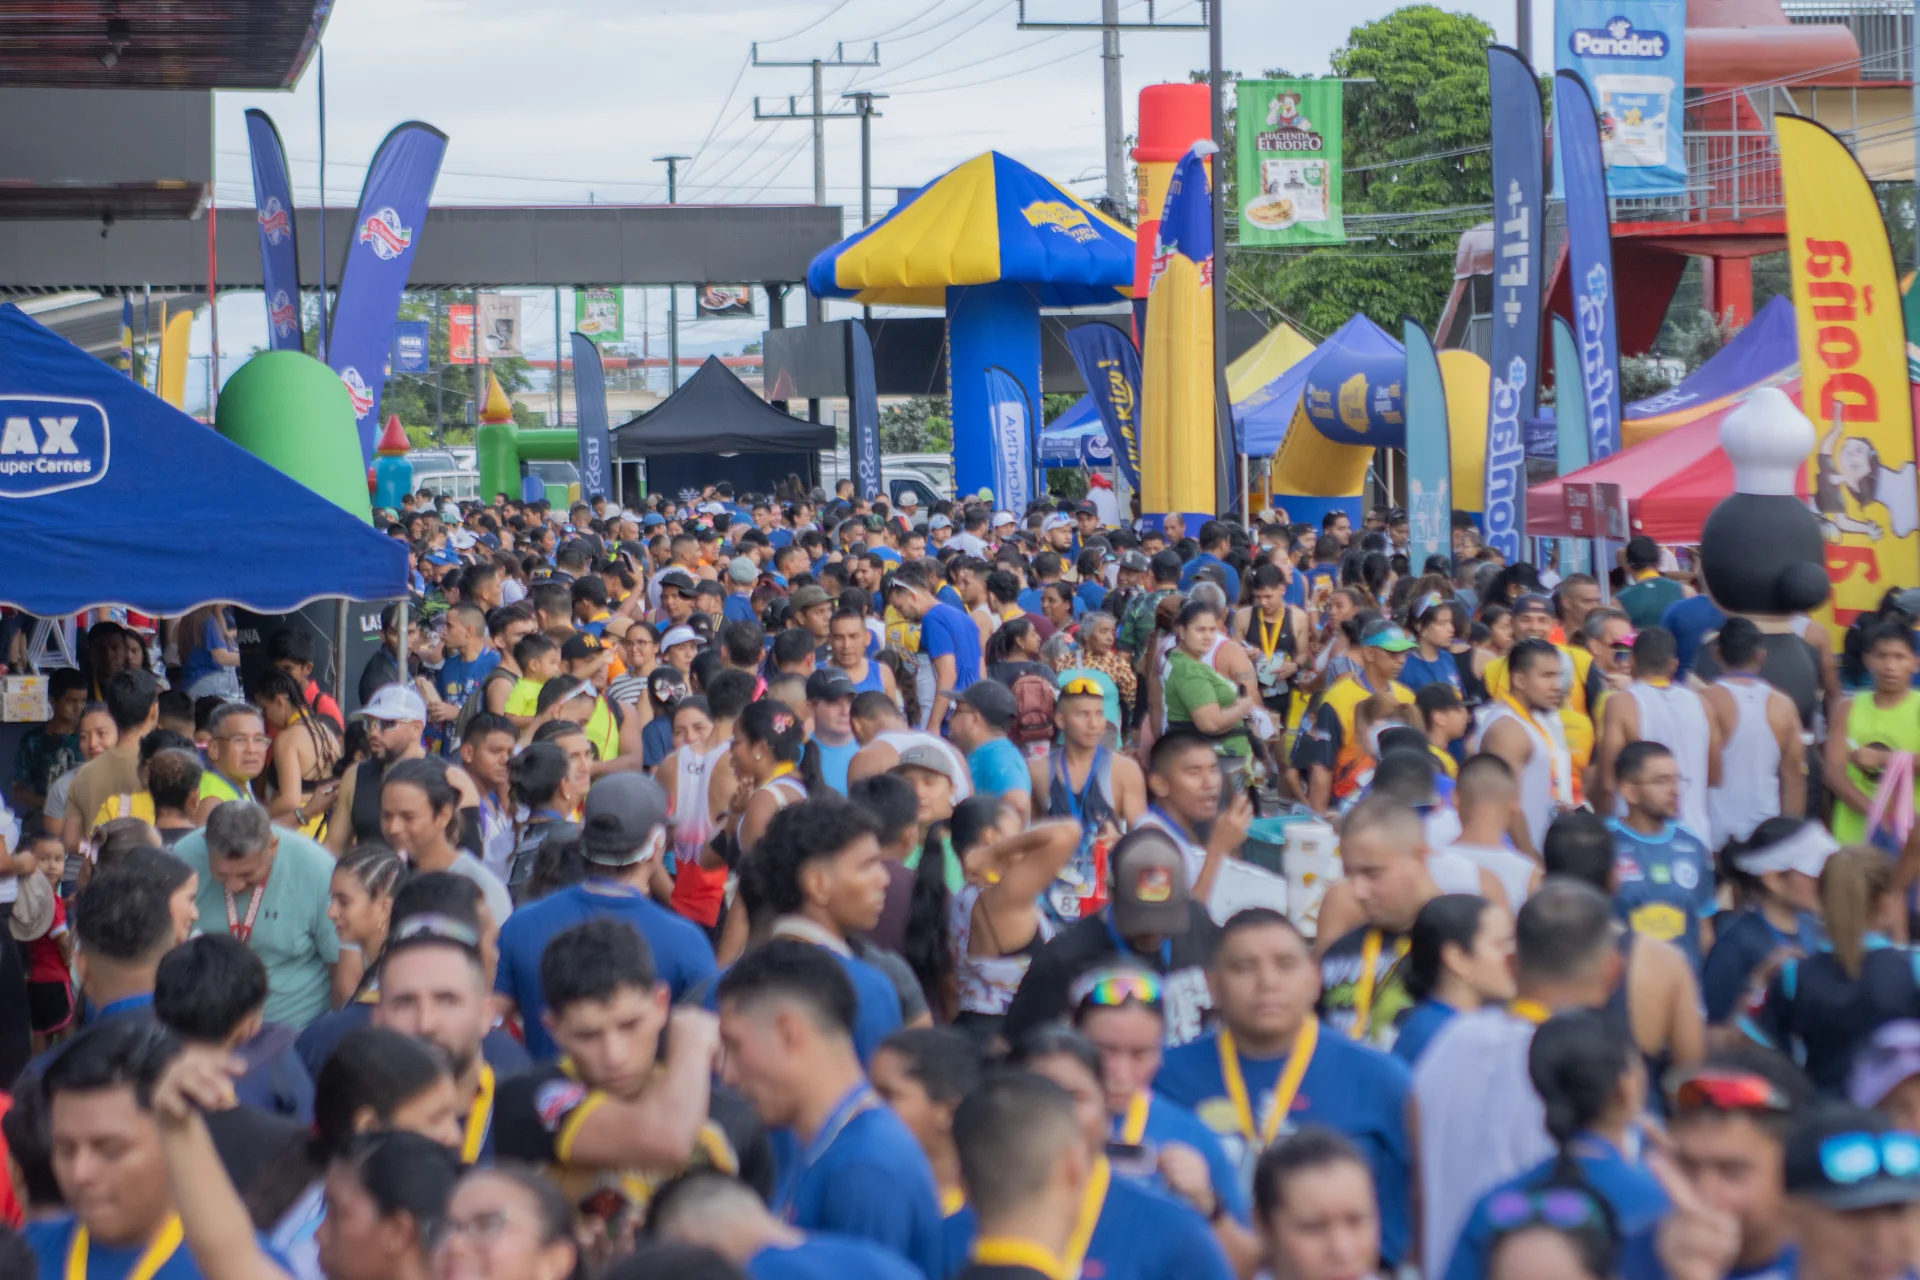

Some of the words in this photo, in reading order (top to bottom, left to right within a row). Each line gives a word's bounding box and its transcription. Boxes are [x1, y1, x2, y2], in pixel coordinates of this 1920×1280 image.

[1575, 31, 1663, 56] Panalat
[1258, 138, 1270, 150] EL
[1276, 137, 1322, 150] RODEO
[1265, 132, 1310, 141] HACIENDA
[0, 416, 79, 454] AX
[0, 457, 91, 476] uperCarnes
